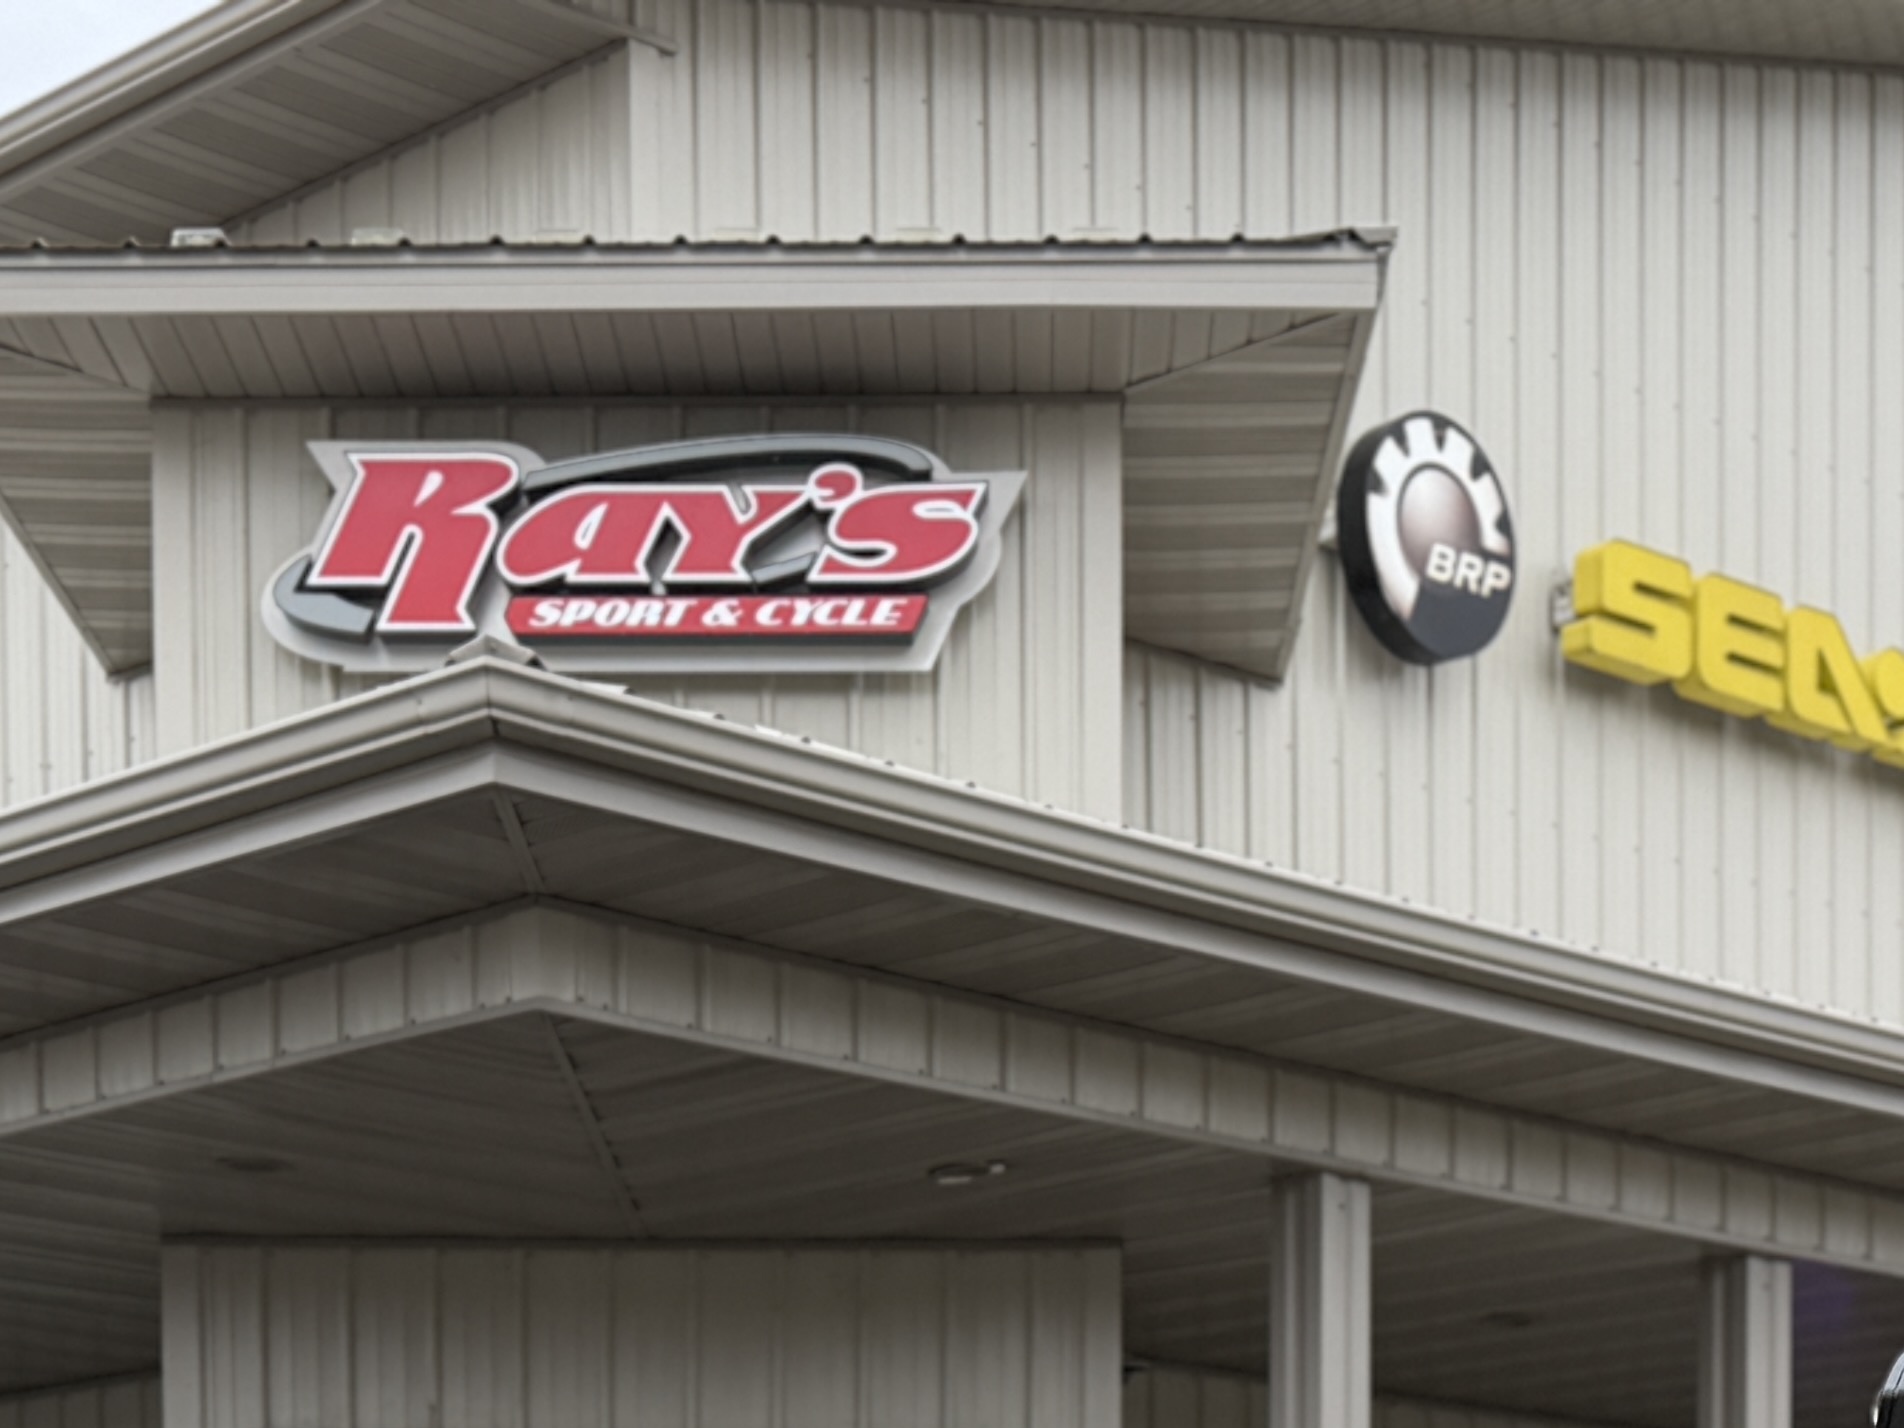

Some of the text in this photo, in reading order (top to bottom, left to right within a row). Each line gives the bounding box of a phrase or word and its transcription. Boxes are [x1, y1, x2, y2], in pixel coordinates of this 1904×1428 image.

[306, 452, 989, 632] Ray's
[1425, 542, 1511, 599] BRP
[527, 597, 908, 629] SPORT & CYCLE
